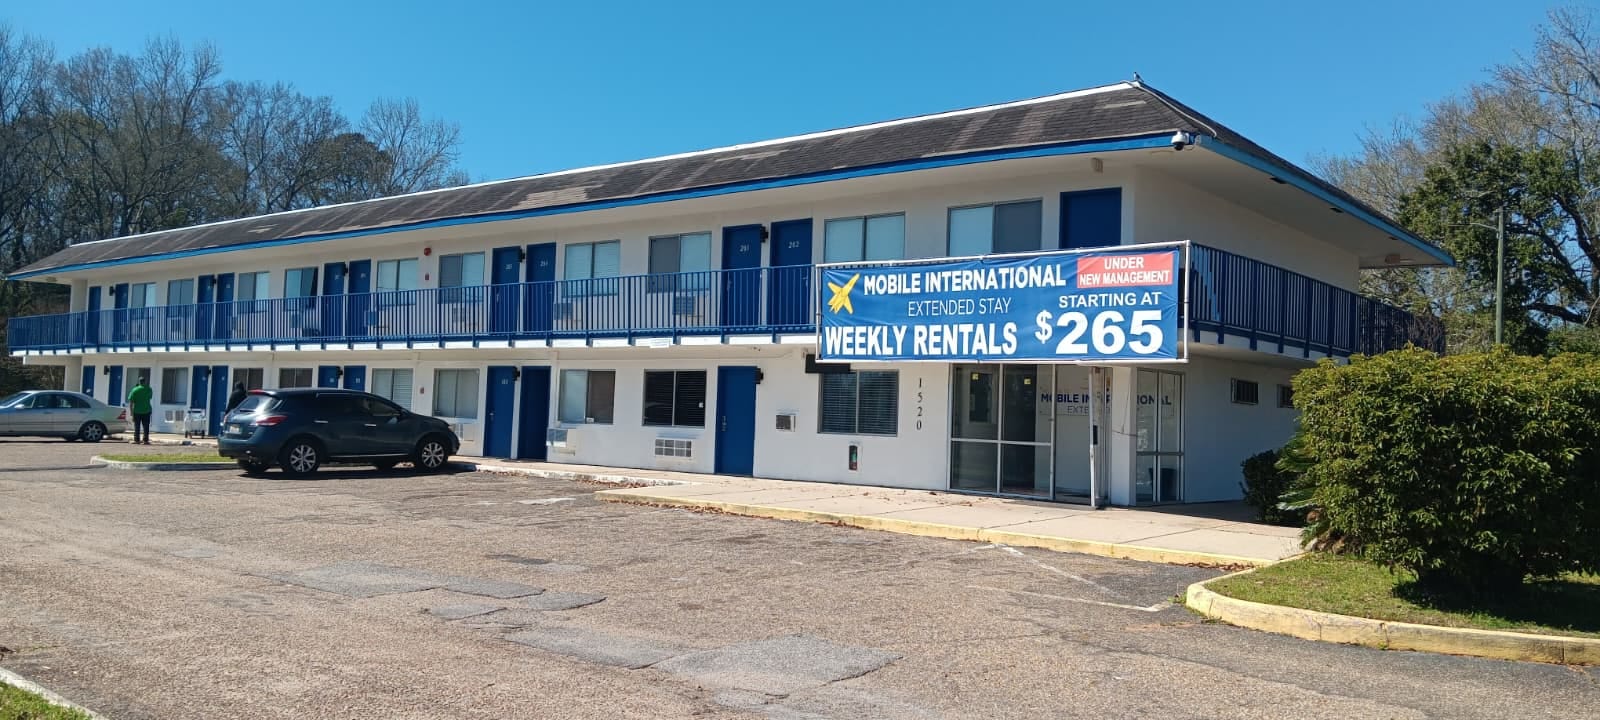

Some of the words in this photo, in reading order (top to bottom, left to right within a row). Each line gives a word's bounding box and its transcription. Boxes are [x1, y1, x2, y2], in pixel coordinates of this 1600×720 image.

[1104, 256, 1144, 270] UNDER
[863, 272, 921, 296] MOBILE
[925, 263, 1066, 293] INTERNATIONAL
[1079, 273, 1101, 286] NEW
[1102, 269, 1170, 285] MANAGEMENT
[908, 299, 975, 317] EXTENDED
[978, 297, 1012, 315] STAY
[1058, 292, 1137, 308] STARTING
[1140, 291, 1162, 306] AT
[825, 324, 907, 356] WEEKLY
[913, 322, 1018, 356] RENTALS
